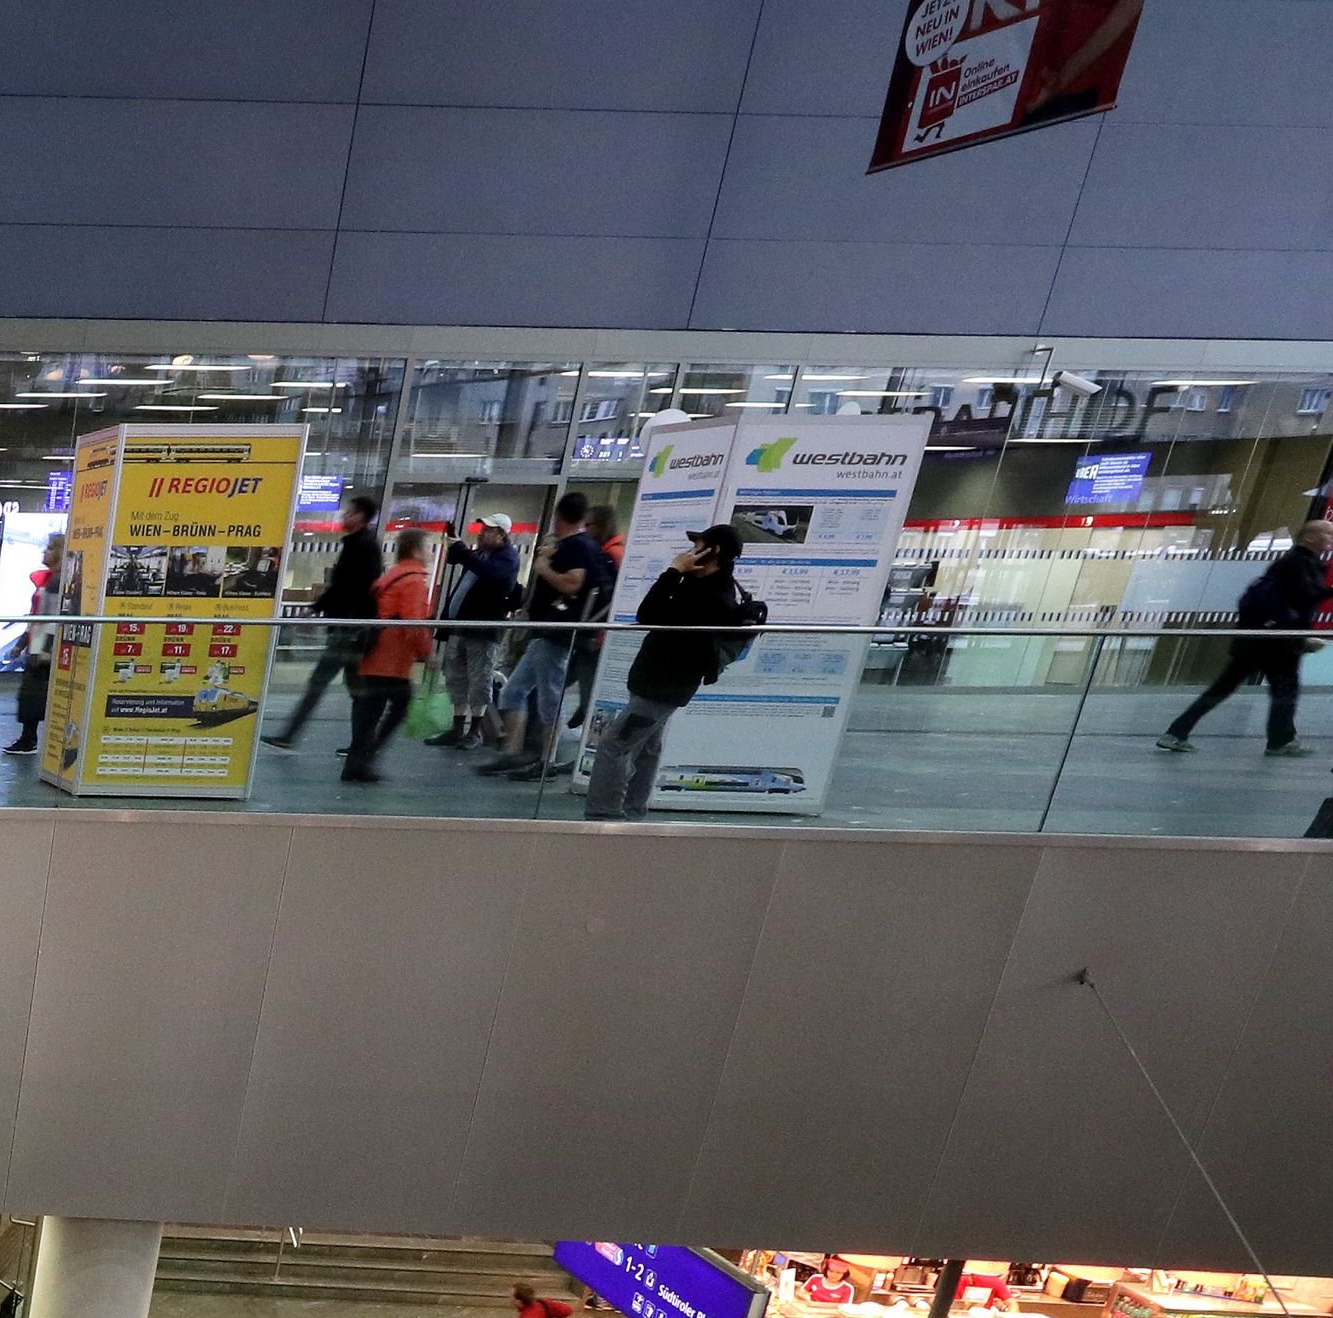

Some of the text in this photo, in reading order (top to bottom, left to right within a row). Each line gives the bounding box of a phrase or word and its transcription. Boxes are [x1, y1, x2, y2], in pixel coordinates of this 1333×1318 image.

[915, 19, 943, 40] NEU
[944, 5, 960, 25] IN
[916, 27, 953, 57] WIEN!
[961, 63, 1010, 92] einkaufen
[963, 58, 995, 79] Online
[669, 452, 724, 470] westbahn
[792, 452, 908, 466] westbahn
[836, 469, 903, 480] westbahn.at
[167, 477, 263, 498] REGIOJET
[130, 522, 262, 537] WIEN BRÜNN PRAG
[625, 1256, 645, 1281] 1-2
[657, 1284, 696, 1318] Südtiroler
